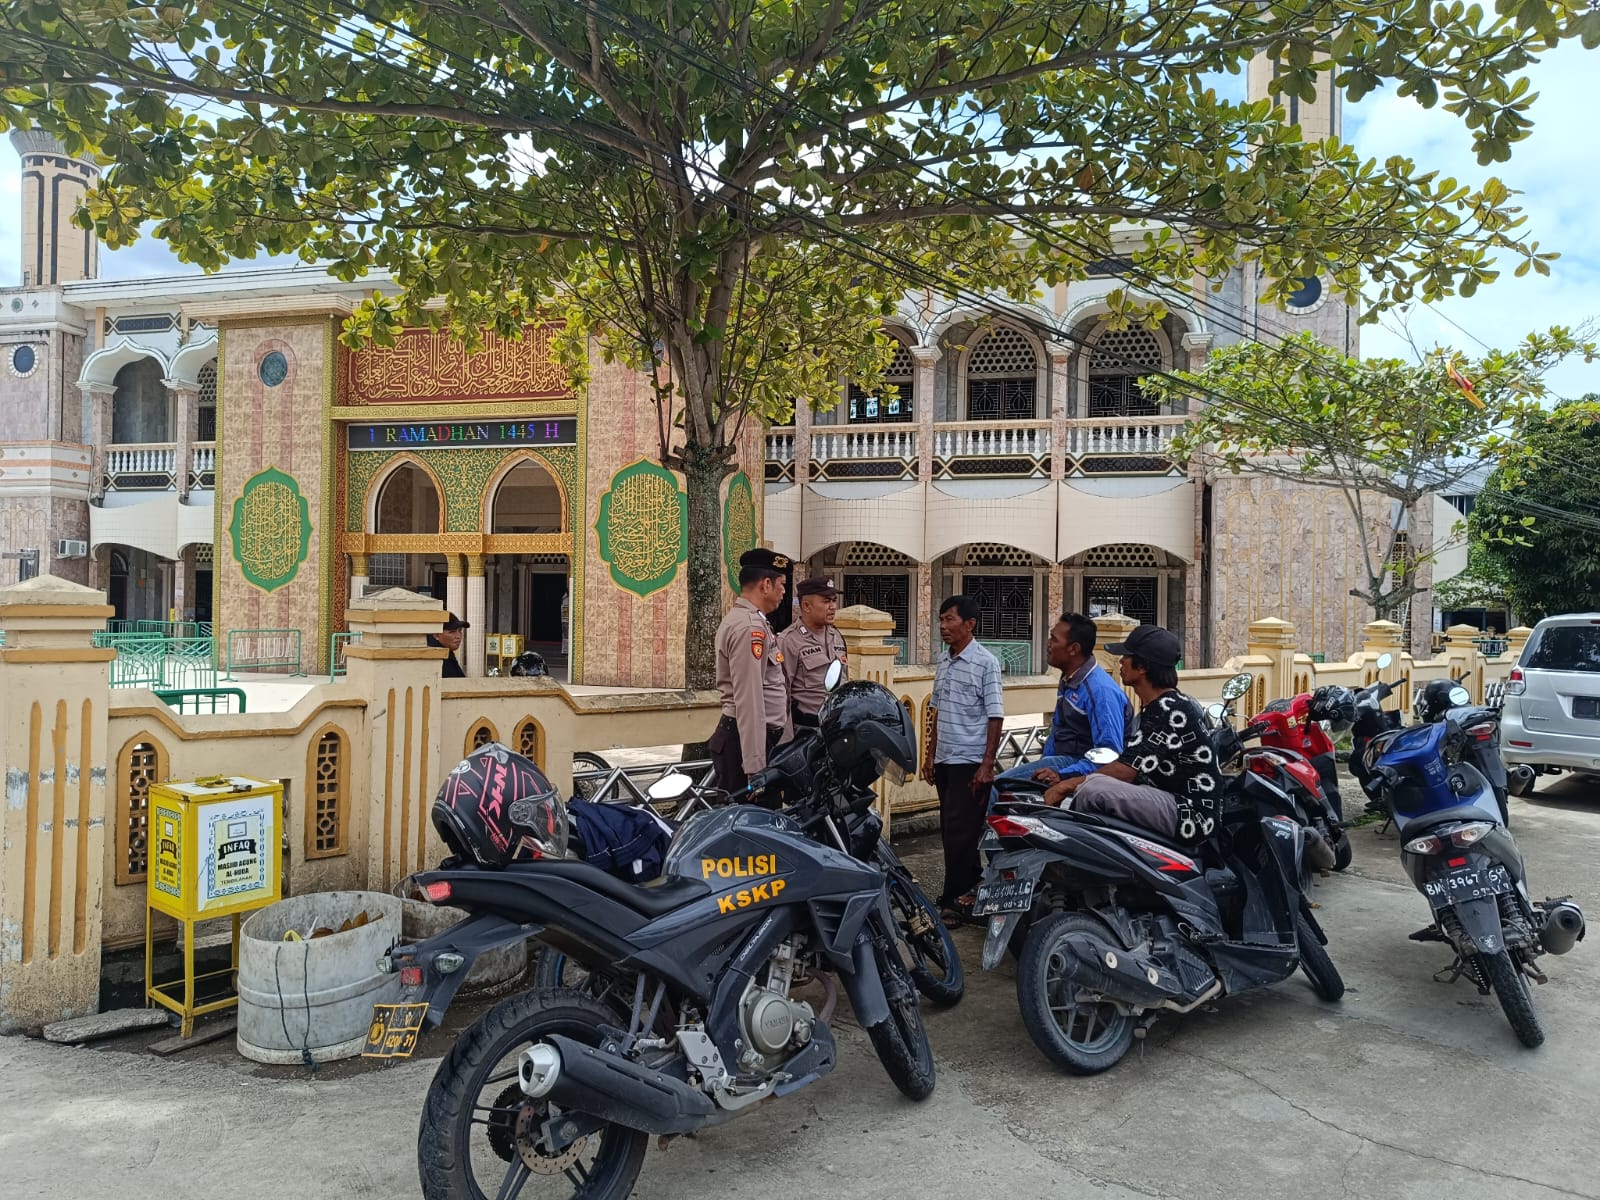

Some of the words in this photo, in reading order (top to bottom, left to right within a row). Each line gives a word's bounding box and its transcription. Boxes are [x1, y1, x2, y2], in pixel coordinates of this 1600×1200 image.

[368, 428, 376, 443] 1
[385, 425, 490, 443] RAMADHAN
[500, 424, 536, 440] 1445
[545, 422, 560, 439] H
[801, 646, 822, 656] IVAN
[223, 840, 251, 855] INFAQ
[701, 854, 776, 879] POLISI
[716, 879, 786, 914] KSKP
